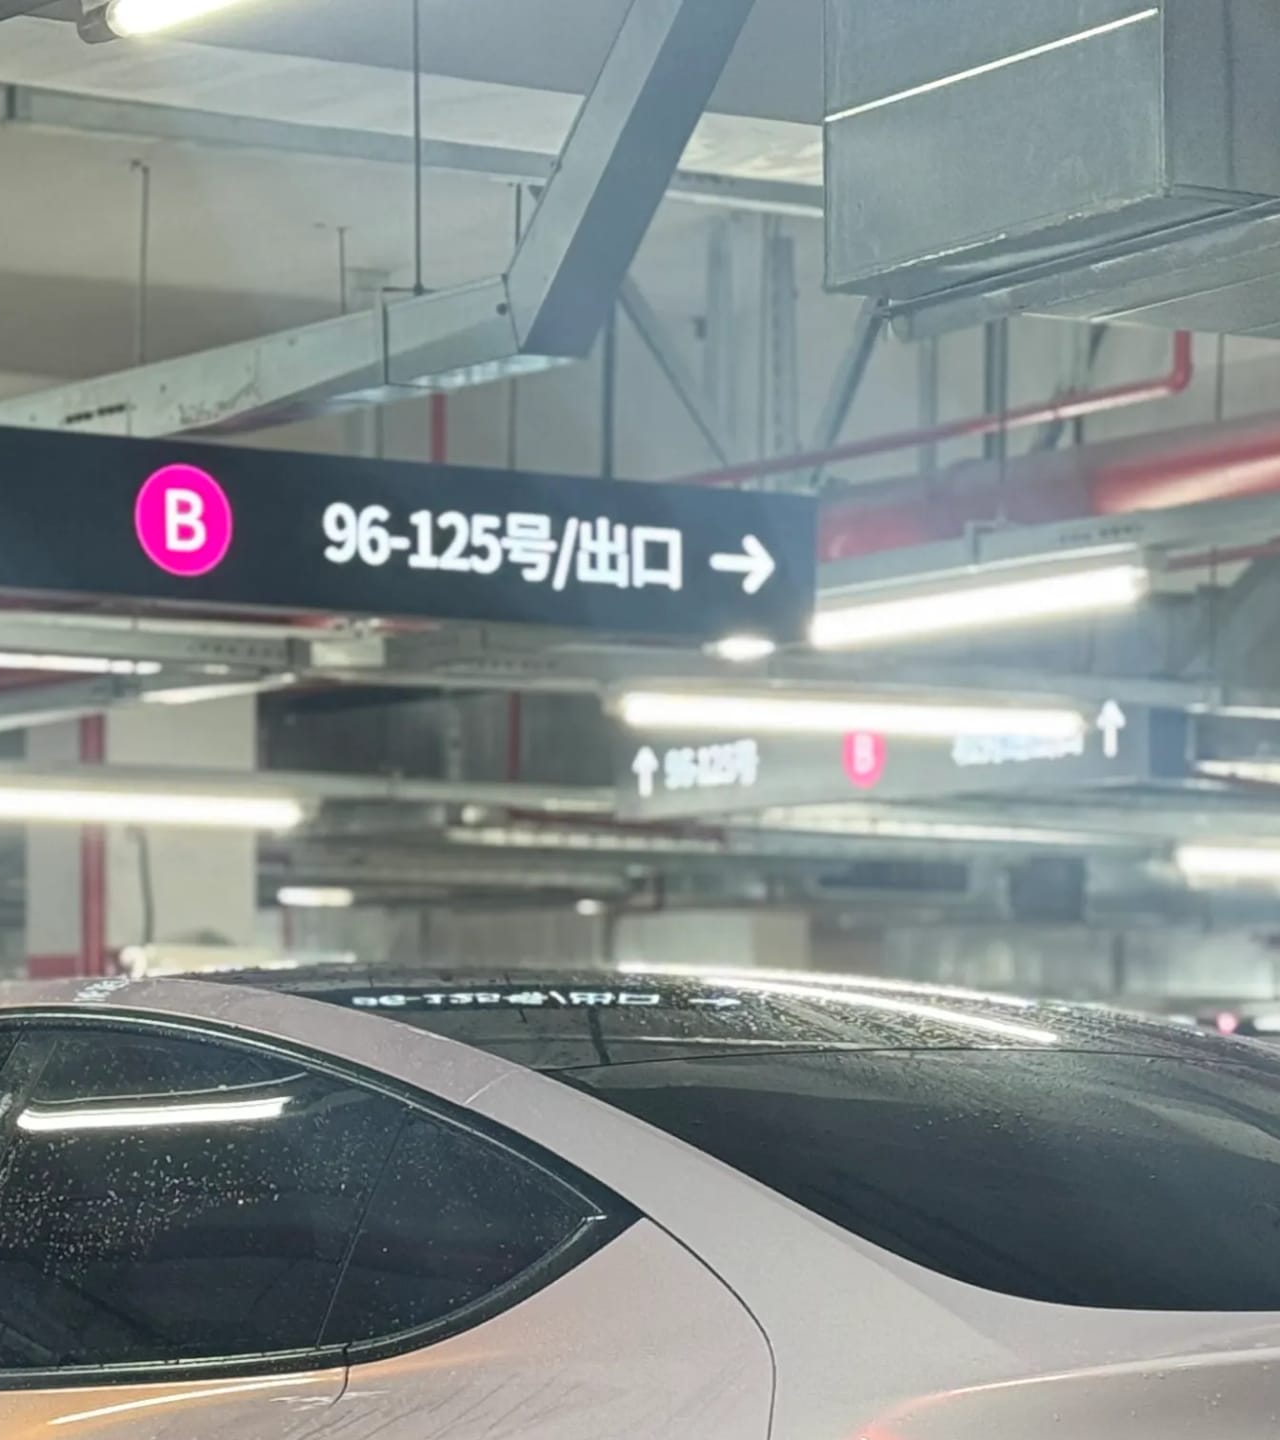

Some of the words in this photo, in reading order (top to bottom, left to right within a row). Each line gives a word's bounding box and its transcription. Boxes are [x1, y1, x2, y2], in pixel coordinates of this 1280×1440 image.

[164, 488, 207, 552] B
[322, 502, 683, 592] 96-125号/出口
